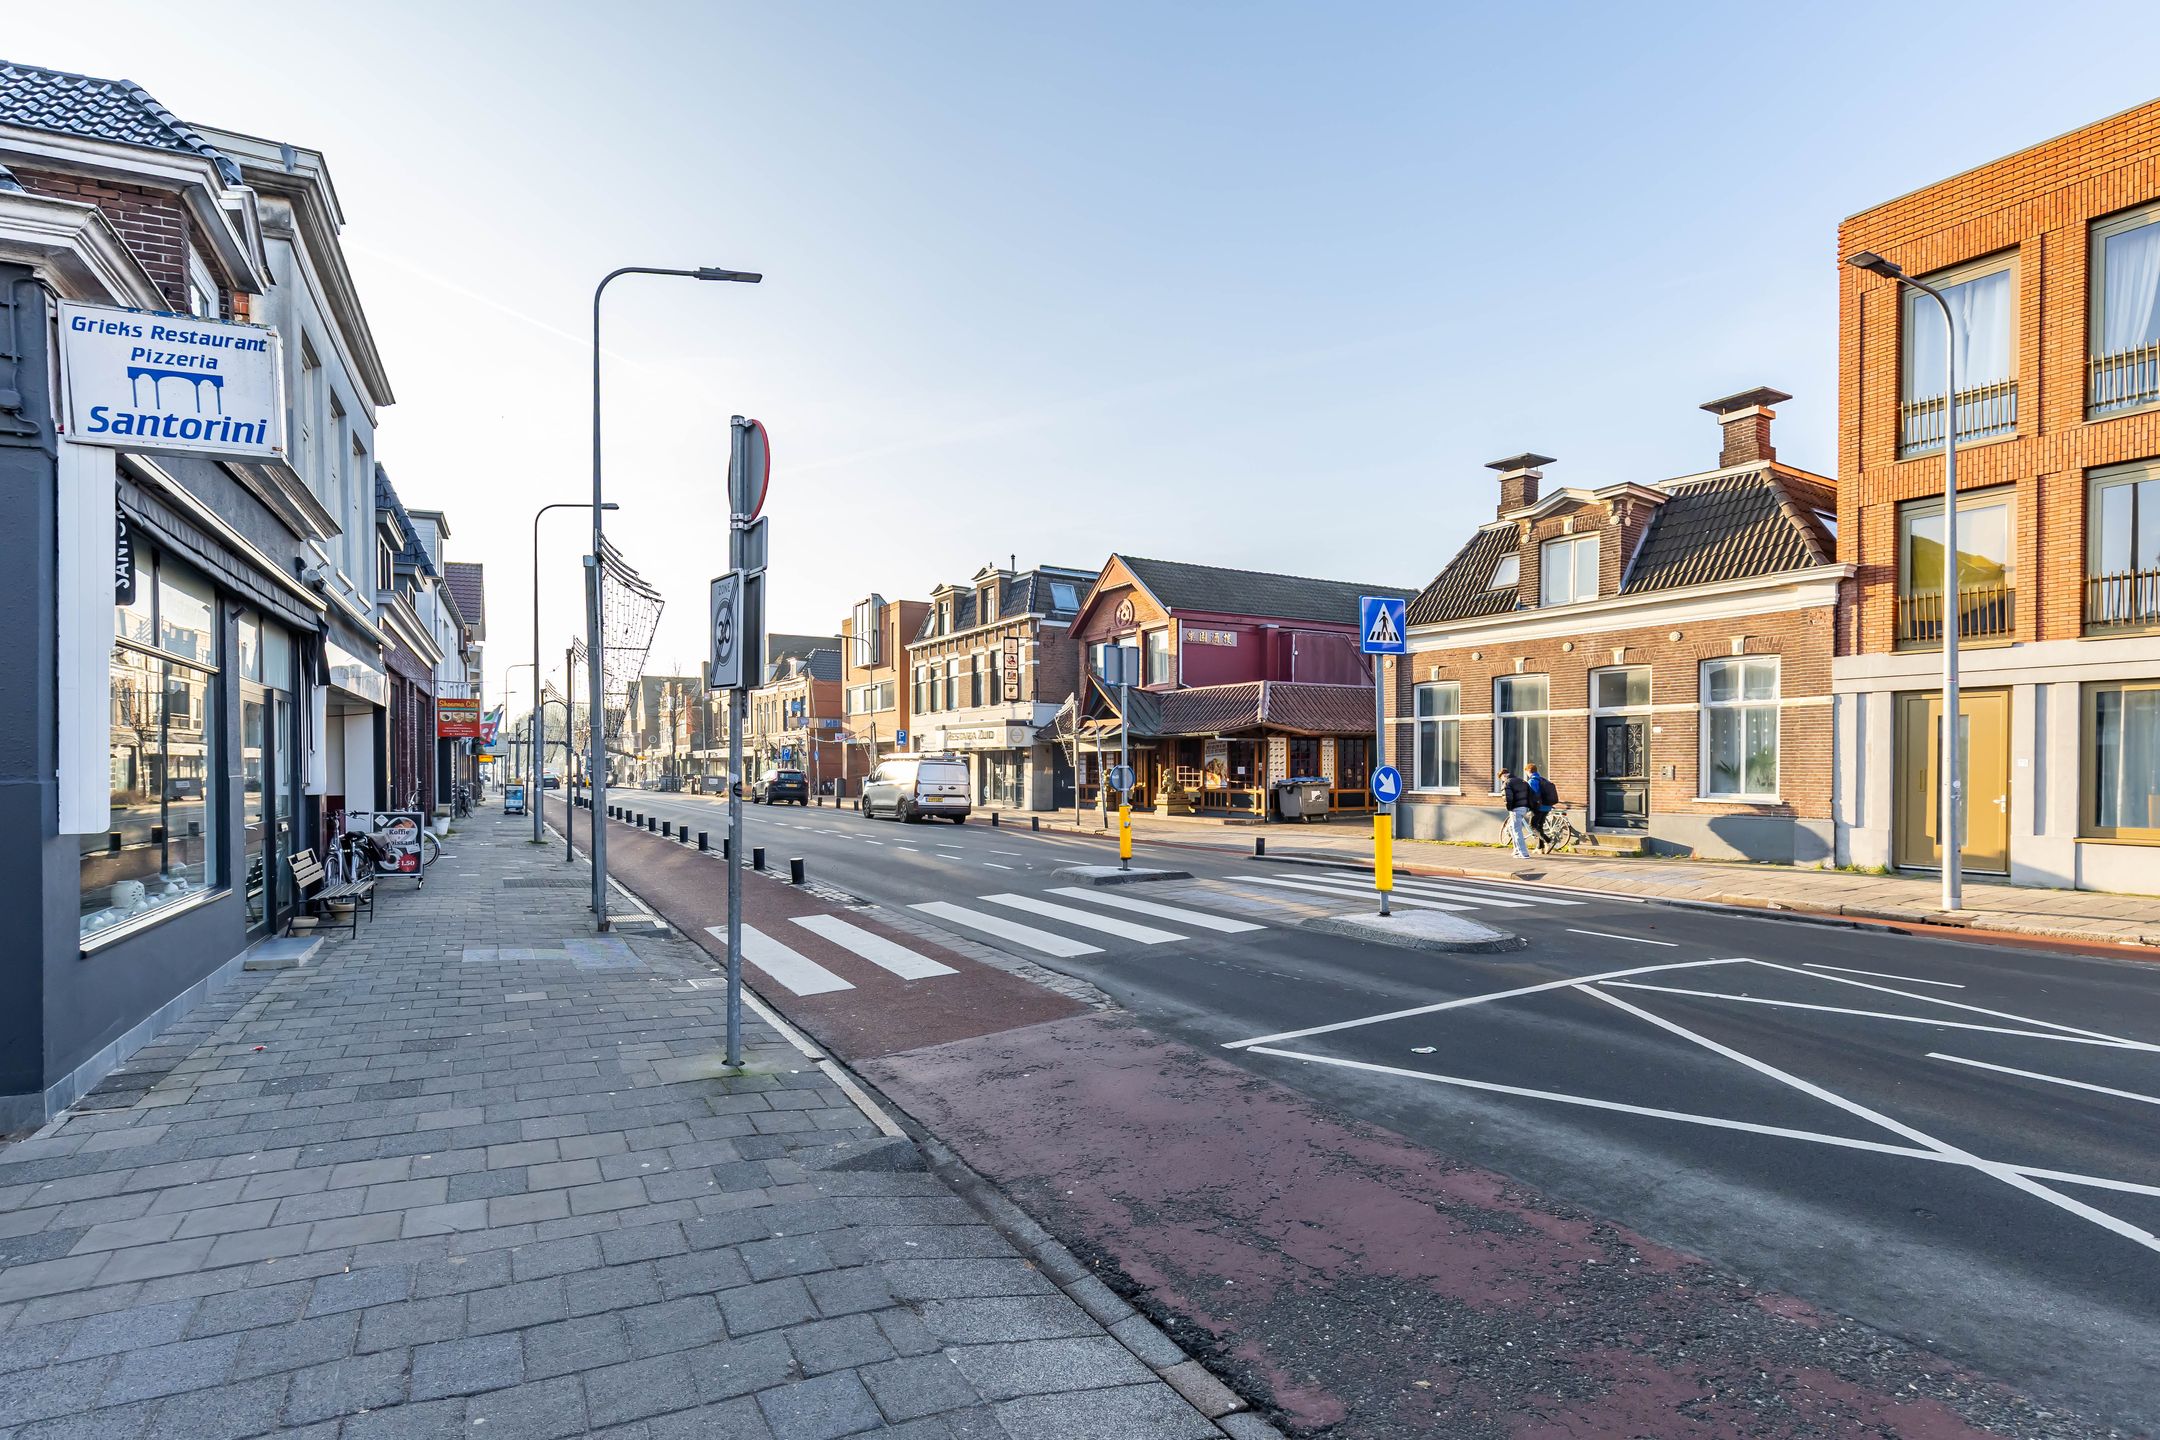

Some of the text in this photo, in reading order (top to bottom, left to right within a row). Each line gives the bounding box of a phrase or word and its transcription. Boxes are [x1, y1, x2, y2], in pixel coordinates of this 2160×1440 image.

[71, 315, 268, 353] Grieks Restaurant
[130, 346, 219, 370] Pizzeria
[87, 405, 267, 445] Santorini
[718, 582, 731, 596] ZONE
[718, 619, 731, 645] 30
